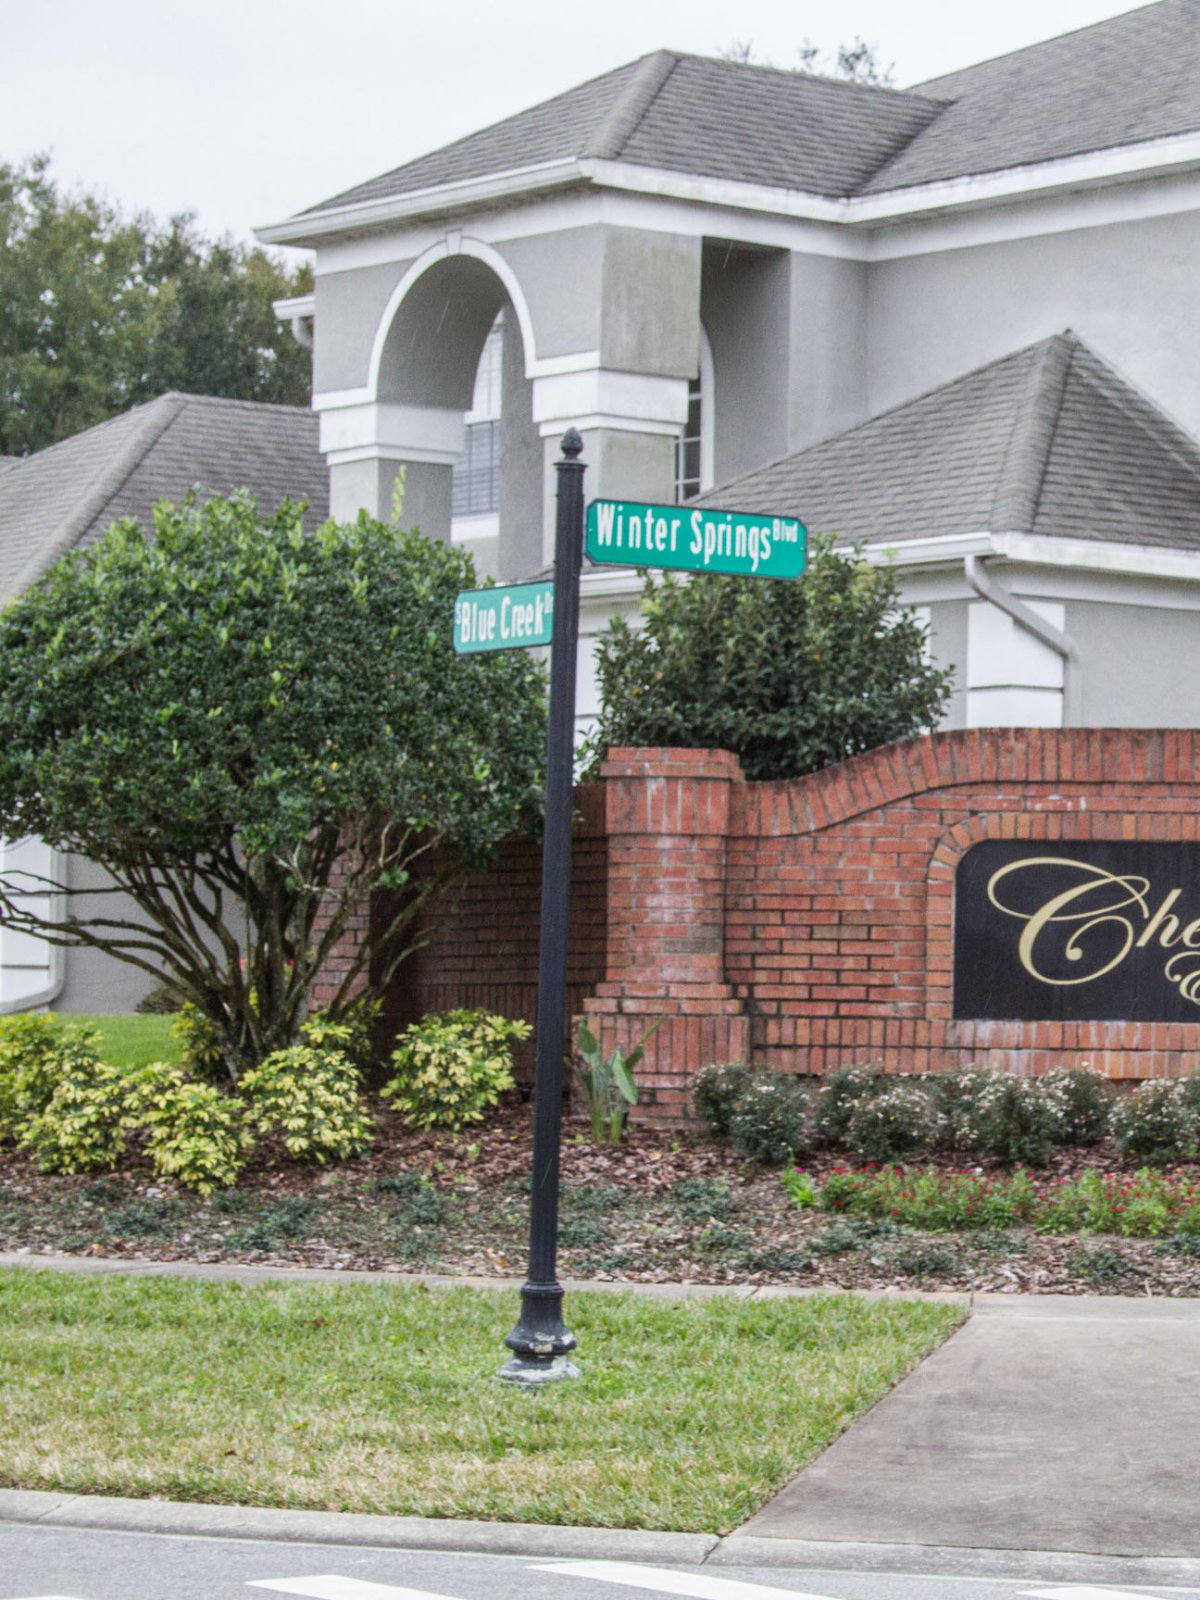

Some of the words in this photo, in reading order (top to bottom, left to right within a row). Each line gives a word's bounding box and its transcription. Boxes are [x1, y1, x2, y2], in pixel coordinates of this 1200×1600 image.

[596, 501, 681, 552] Winter
[689, 510, 772, 572] Springs
[772, 518, 799, 543] Blvd
[460, 601, 497, 644] Blue
[500, 594, 544, 640] Creek
